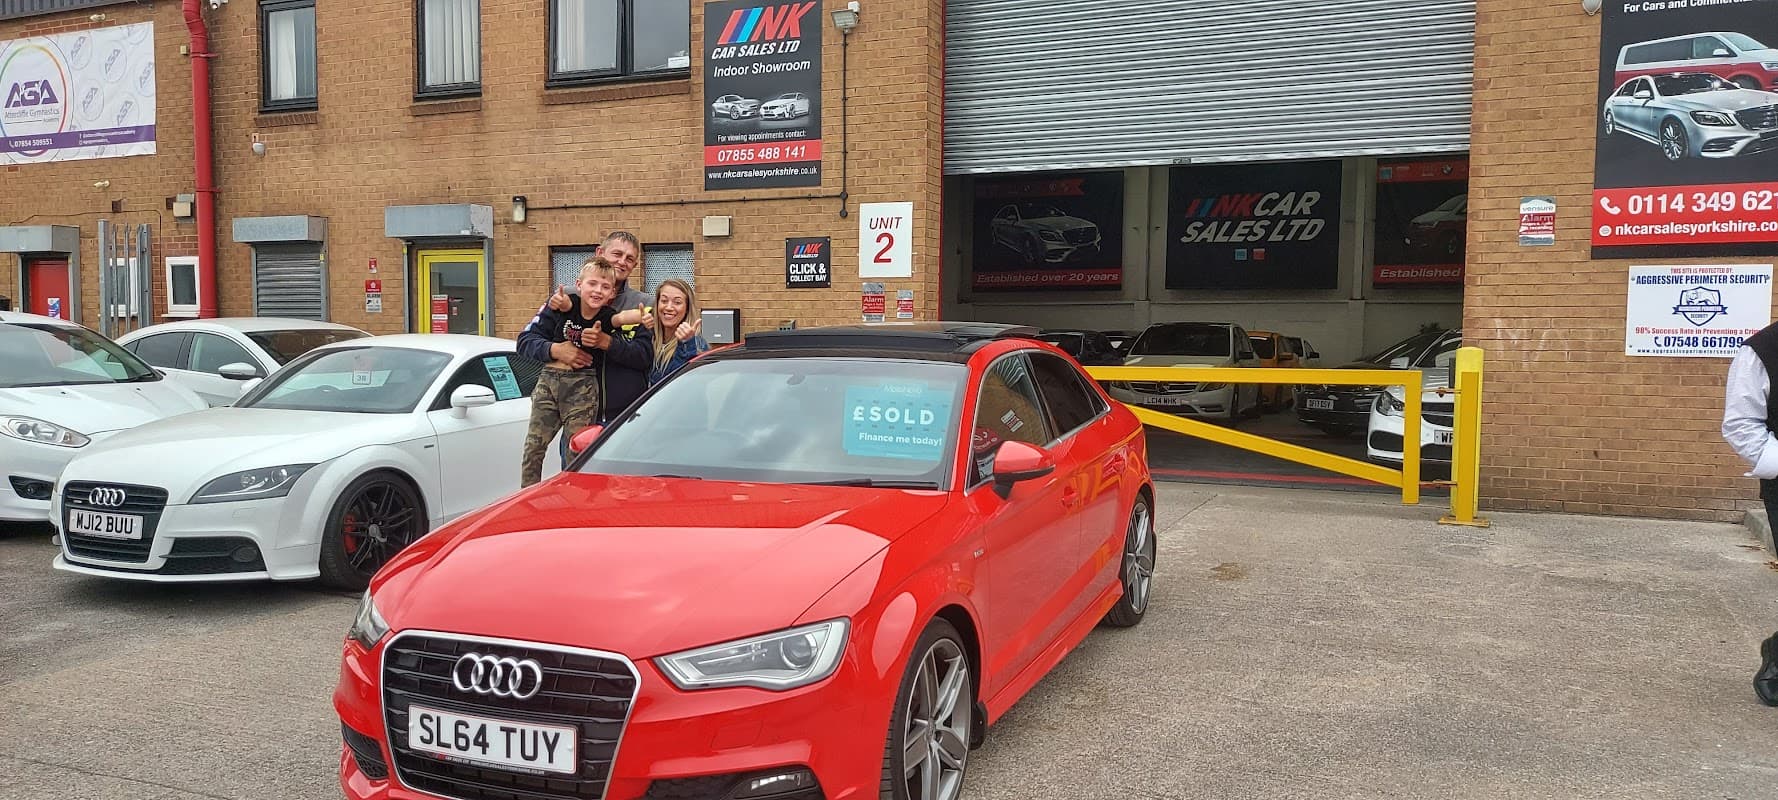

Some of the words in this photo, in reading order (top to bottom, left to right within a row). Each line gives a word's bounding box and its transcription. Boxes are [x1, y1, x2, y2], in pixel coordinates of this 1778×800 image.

[1623, 3, 1640, 13] For
[1642, 1, 1666, 12] Cars
[1667, 0, 1687, 9] and
[712, 46, 737, 59] CAR
[738, 42, 776, 57] SALES
[778, 40, 801, 53] LTD
[714, 65, 750, 77] Indoor
[752, 60, 811, 74] Showroom
[4, 79, 59, 108] AGA
[717, 134, 727, 142] For
[718, 149, 755, 162] 07855
[757, 147, 780, 159] 488
[784, 145, 806, 157] 141
[708, 166, 817, 179] www.nkcarsalesyorkshire.co.uk
[1627, 193, 1685, 215] 0114
[1691, 191, 1736, 213] 349
[868, 216, 903, 230] UNIT
[1521, 214, 1553, 222] Alarm
[1181, 221, 1269, 243] SALES
[1268, 218, 1326, 241] LTD
[873, 232, 895, 264] 2
[789, 263, 817, 275] CLICK
[818, 262, 826, 274] &
[1379, 267, 1461, 279] Established
[976, 274, 1038, 283] Established
[1041, 274, 1065, 282] over
[1068, 272, 1084, 281] 20
[1086, 272, 1119, 284] years
[1636, 275, 1684, 285] AGGRESSIVE
[1685, 275, 1728, 284] PERIMETER
[1729, 274, 1769, 284] SECURITY
[1651, 327, 1679, 335] Success
[1703, 327, 1738, 335] Preventing
[1664, 336, 1699, 347] 07548
[1701, 336, 1744, 347] 661799
[859, 432, 894, 443] Finance
[912, 437, 942, 447] today!
[76, 513, 103, 532] MJ12
[105, 516, 134, 534] BUU
[419, 713, 490, 755] SL64
[500, 727, 561, 764] TUY
